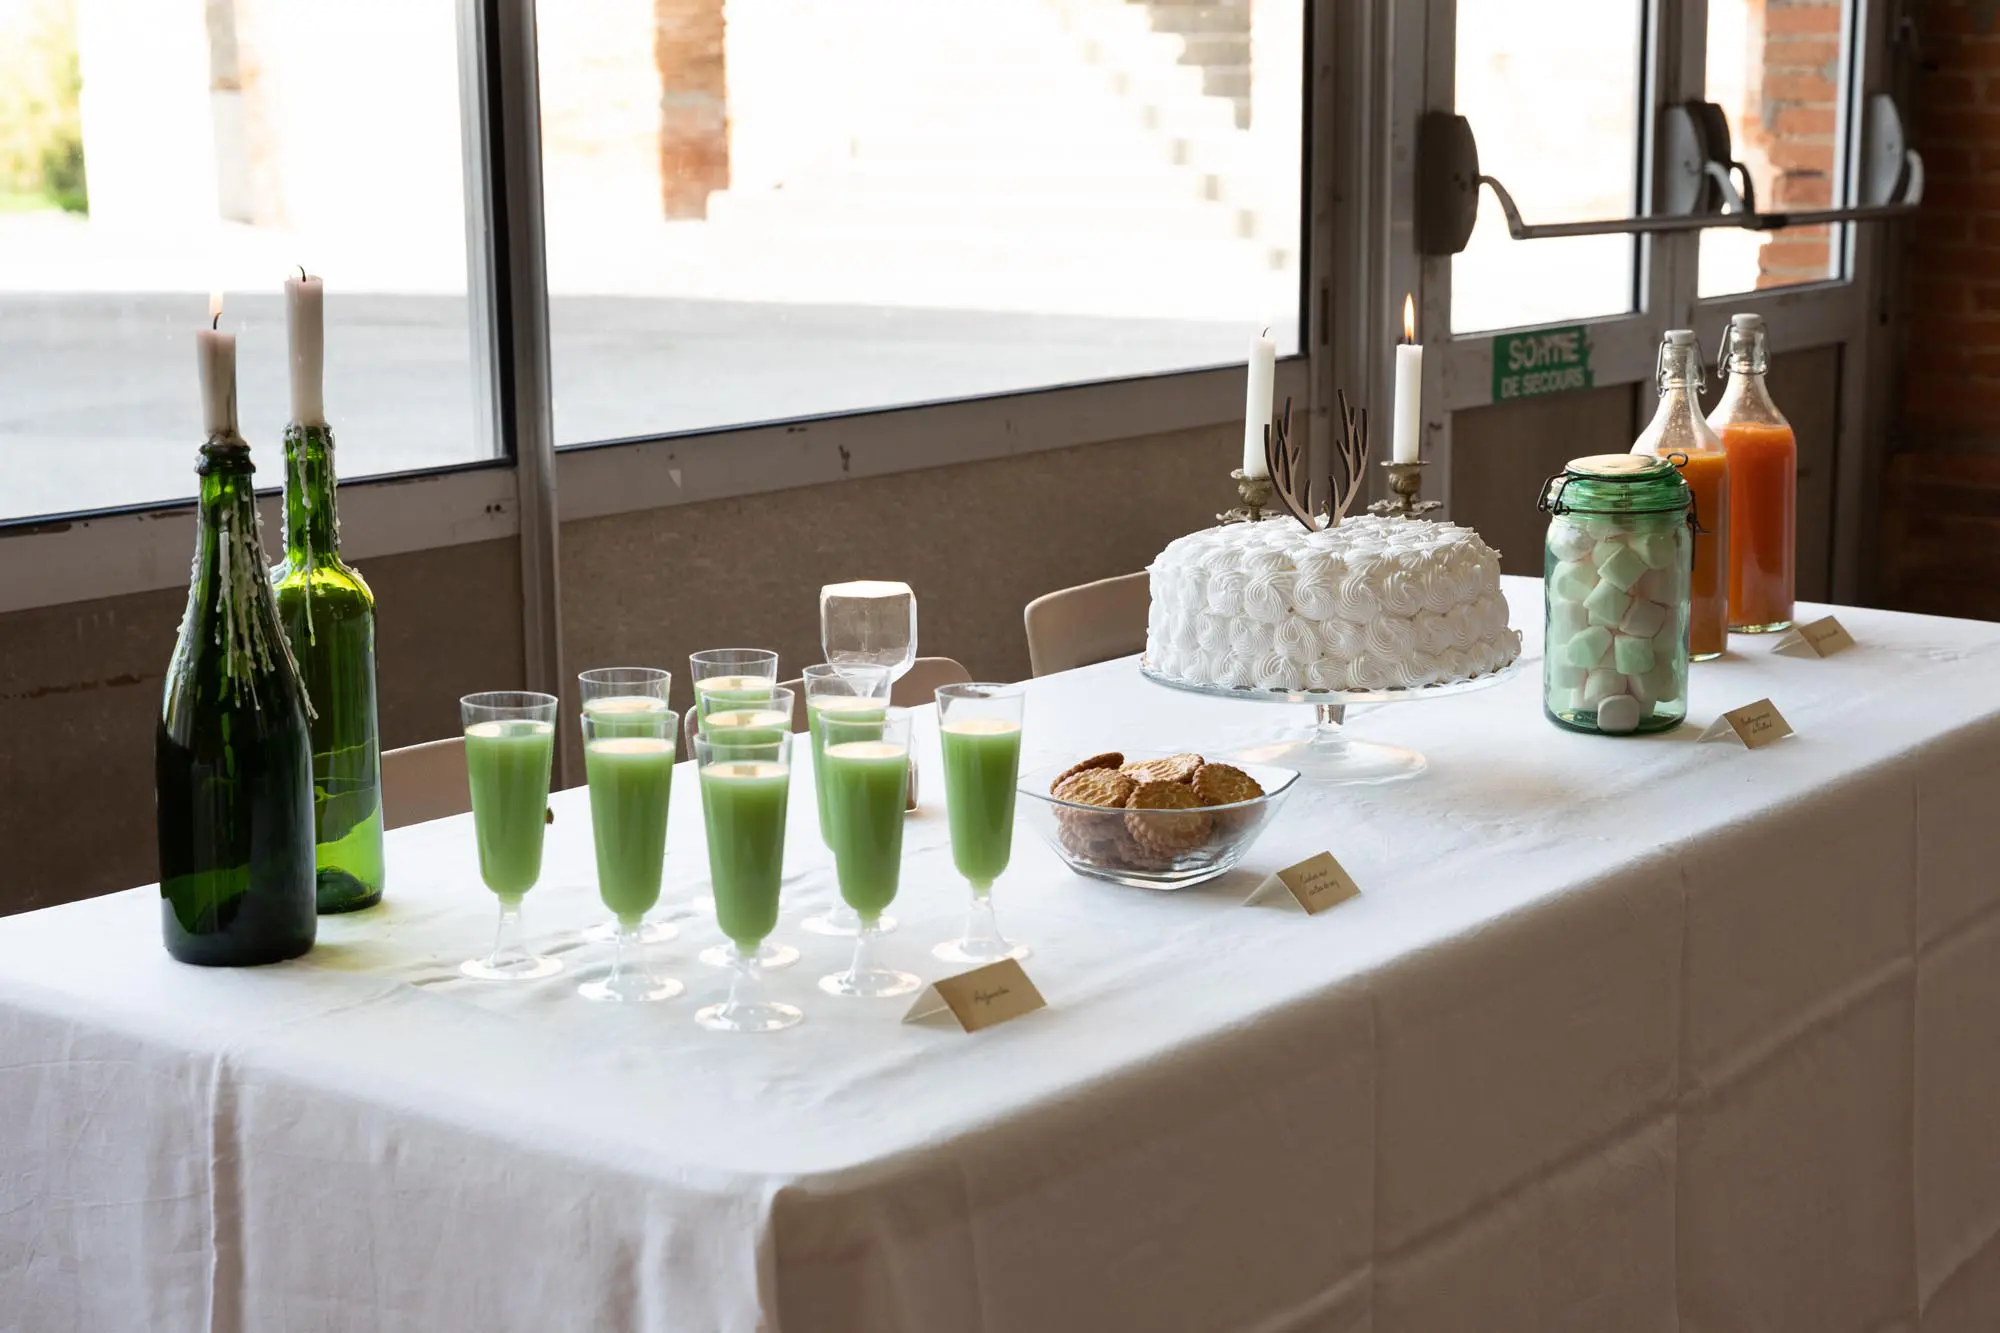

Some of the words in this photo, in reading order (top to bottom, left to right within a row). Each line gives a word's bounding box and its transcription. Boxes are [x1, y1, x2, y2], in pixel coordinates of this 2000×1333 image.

[1508, 332, 1580, 370] SORTIE
[1501, 375, 1520, 399] DE
[1522, 366, 1585, 396] SECOURS
